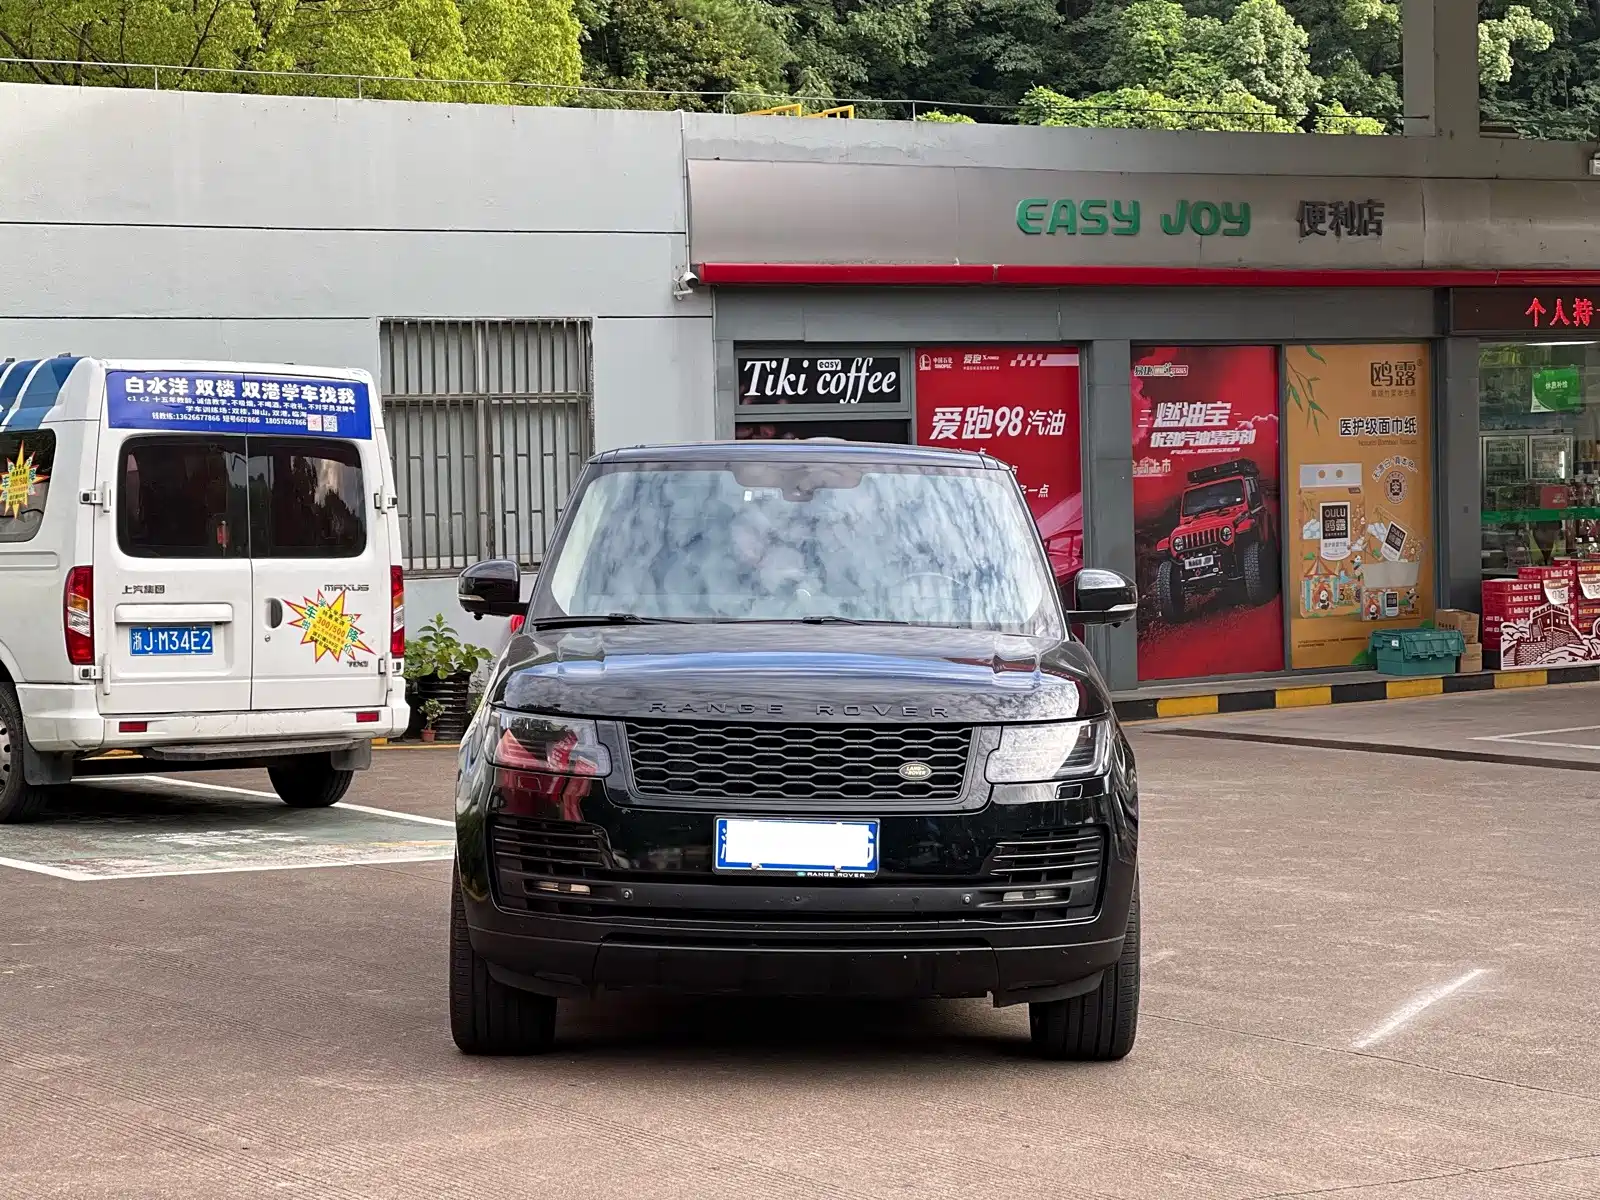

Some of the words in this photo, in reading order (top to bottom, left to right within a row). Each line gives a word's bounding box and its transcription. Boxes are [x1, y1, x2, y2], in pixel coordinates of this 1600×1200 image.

[1015, 198, 1141, 236] EASY
[1160, 199, 1252, 237] JOY
[1295, 198, 1385, 238] 便利店
[1525, 297, 1600, 327] 个人持
[818, 361, 840, 371] easy
[1370, 361, 1416, 386] 鸥露
[125, 376, 189, 396] 白水洋
[195, 379, 236, 398] 双楼
[241, 381, 356, 405] 双港学车找我
[743, 358, 809, 397] Tiki
[815, 357, 897, 404] coffee
[1153, 401, 1232, 427] 燃油宝
[1339, 416, 1417, 436] 医护级面巾纸
[1324, 508, 1346, 518] OULU
[121, 585, 165, 594] 上汽集团
[324, 584, 370, 592] MAXUS
[649, 703, 784, 715] RANGE
[815, 704, 949, 718] ROVER
